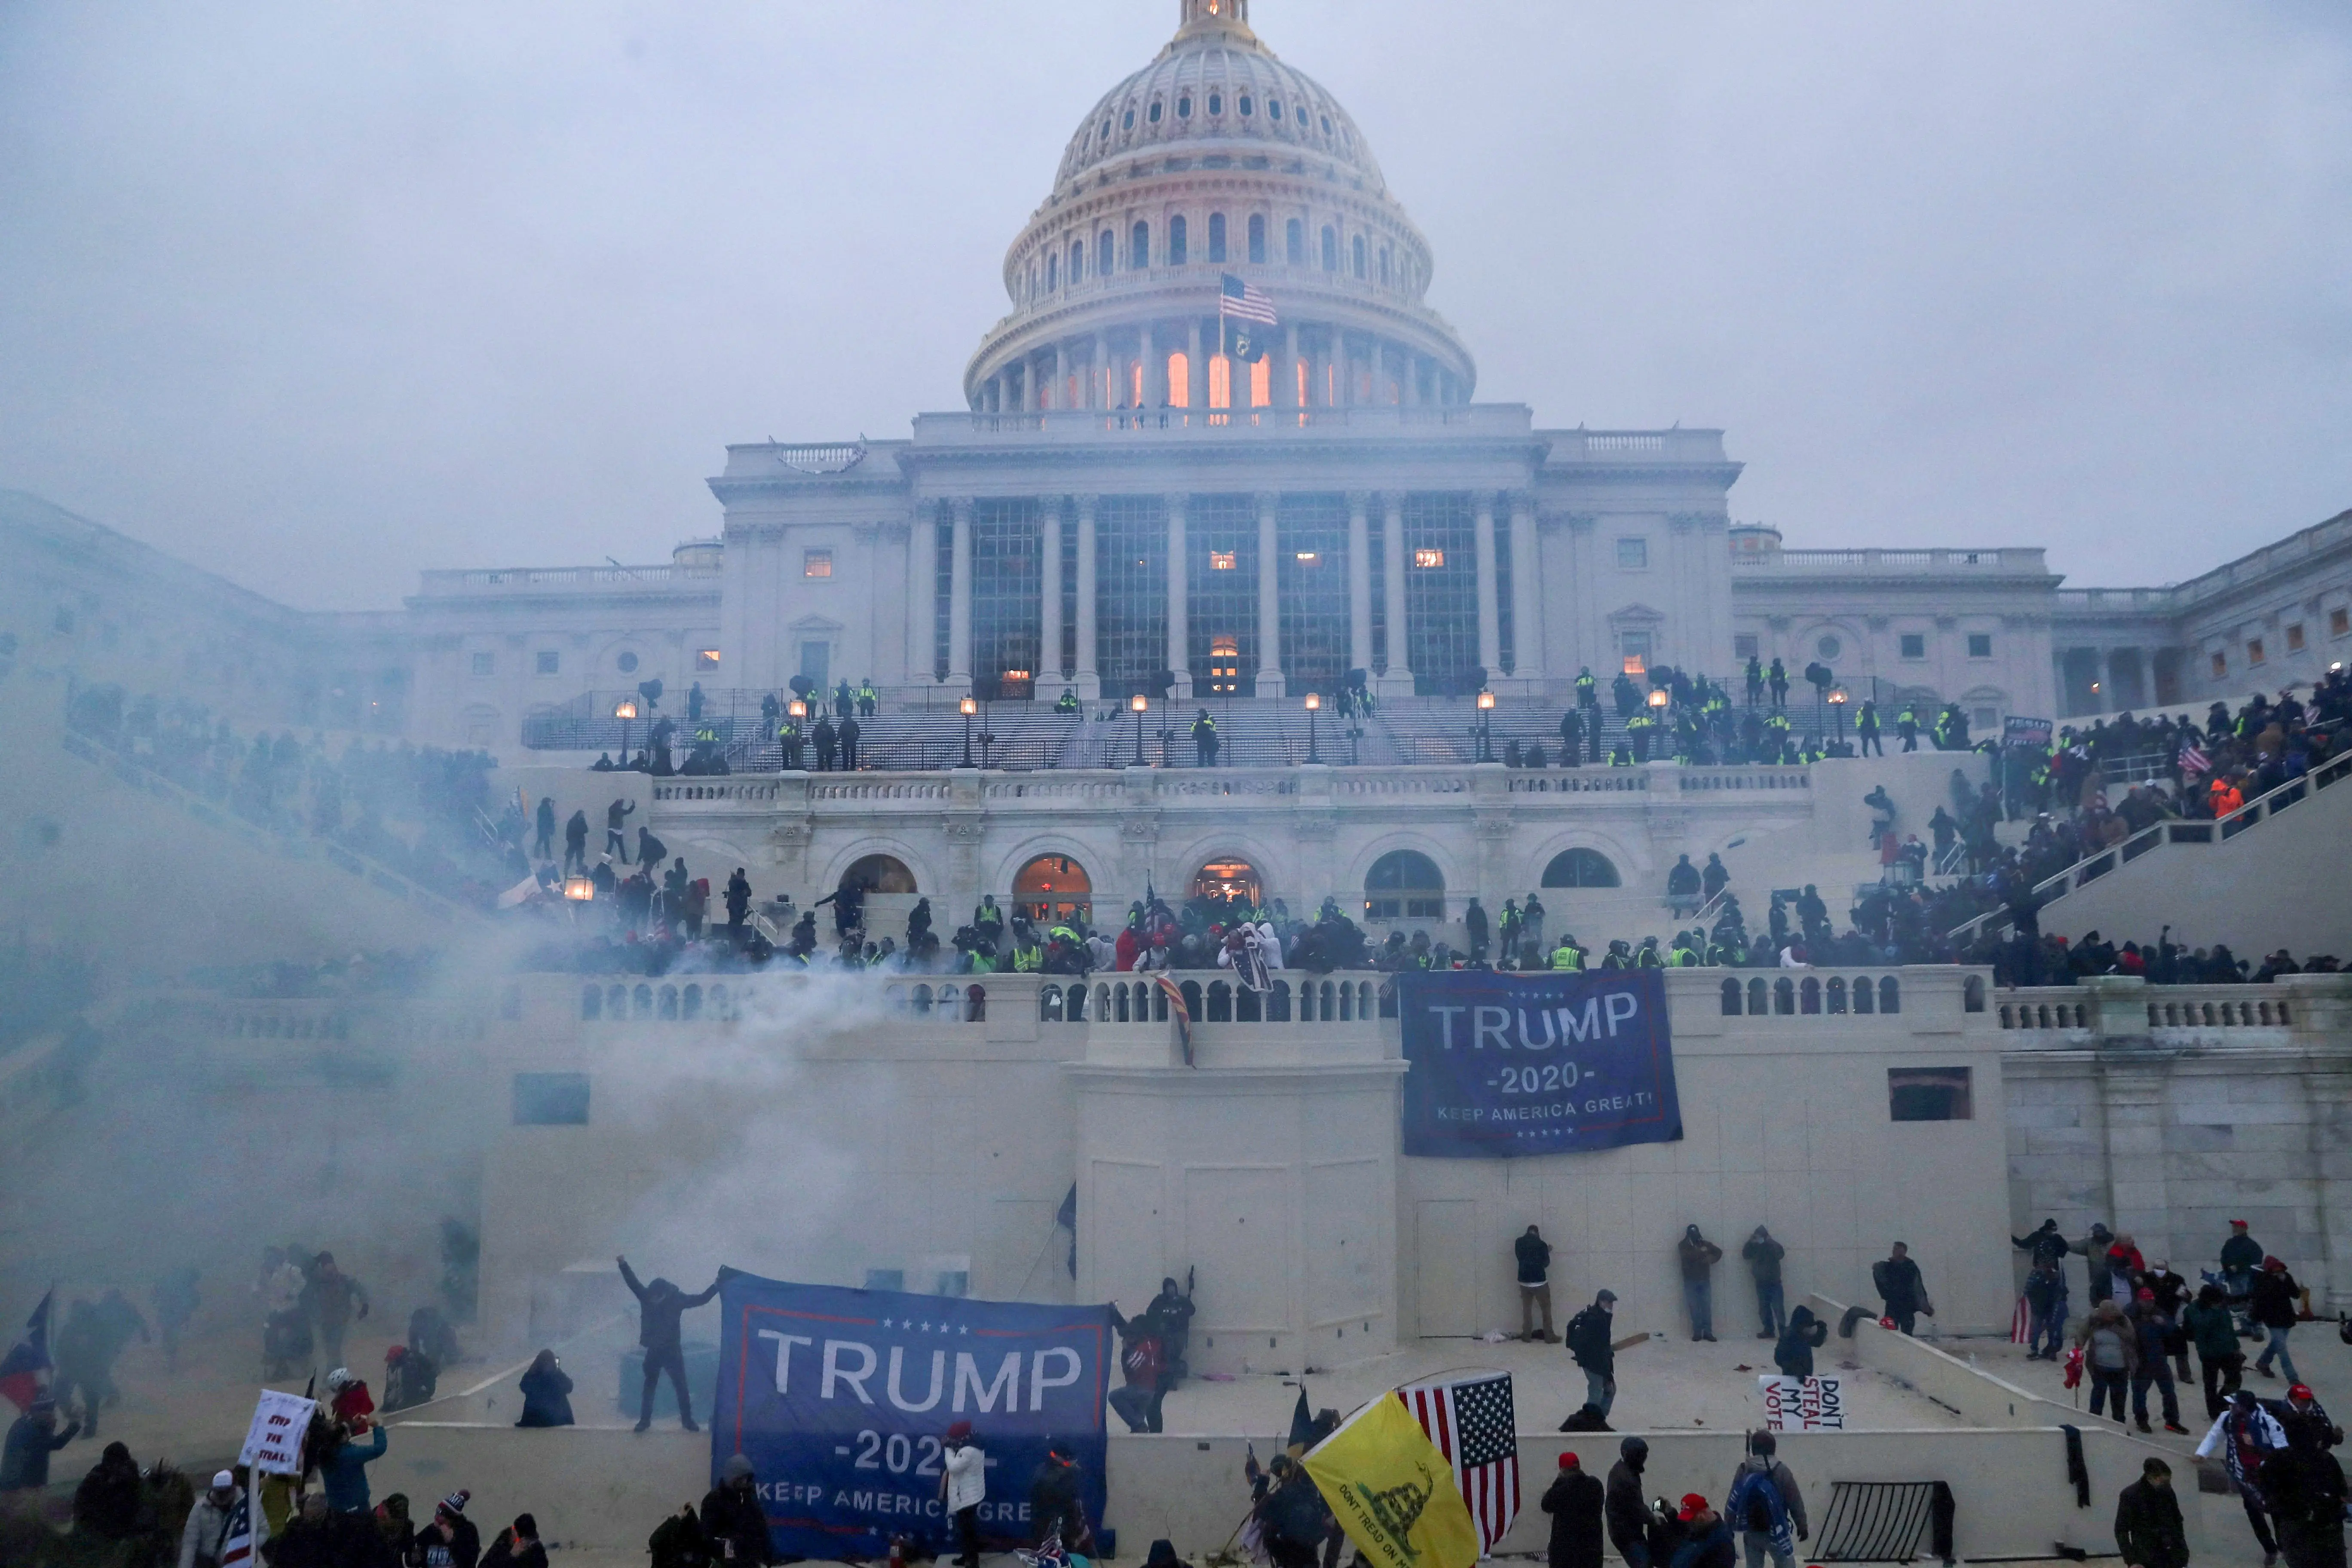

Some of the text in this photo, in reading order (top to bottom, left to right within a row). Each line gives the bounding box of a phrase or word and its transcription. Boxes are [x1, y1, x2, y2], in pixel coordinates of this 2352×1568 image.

[1428, 992, 1638, 1050] TRUMP
[1487, 1061, 1595, 1094] -2020-
[1438, 1092, 1653, 1121] KEEP AMERICA GREAT!
[757, 1329, 1081, 1413] TRUMP
[1765, 1381, 1783, 1430] VOTE
[1781, 1388, 1803, 1418] MY
[1803, 1377, 1821, 1430] STEAL
[1821, 1380, 1844, 1430] DON'T
[259, 1449, 286, 1462] STEAL
[835, 1429, 998, 1476] -202-
[834, 1489, 951, 1518] AMERIC
[1358, 1511, 1384, 1543] TREAD
[1383, 1544, 1398, 1560] ON
[1395, 1559, 1411, 1568] M
